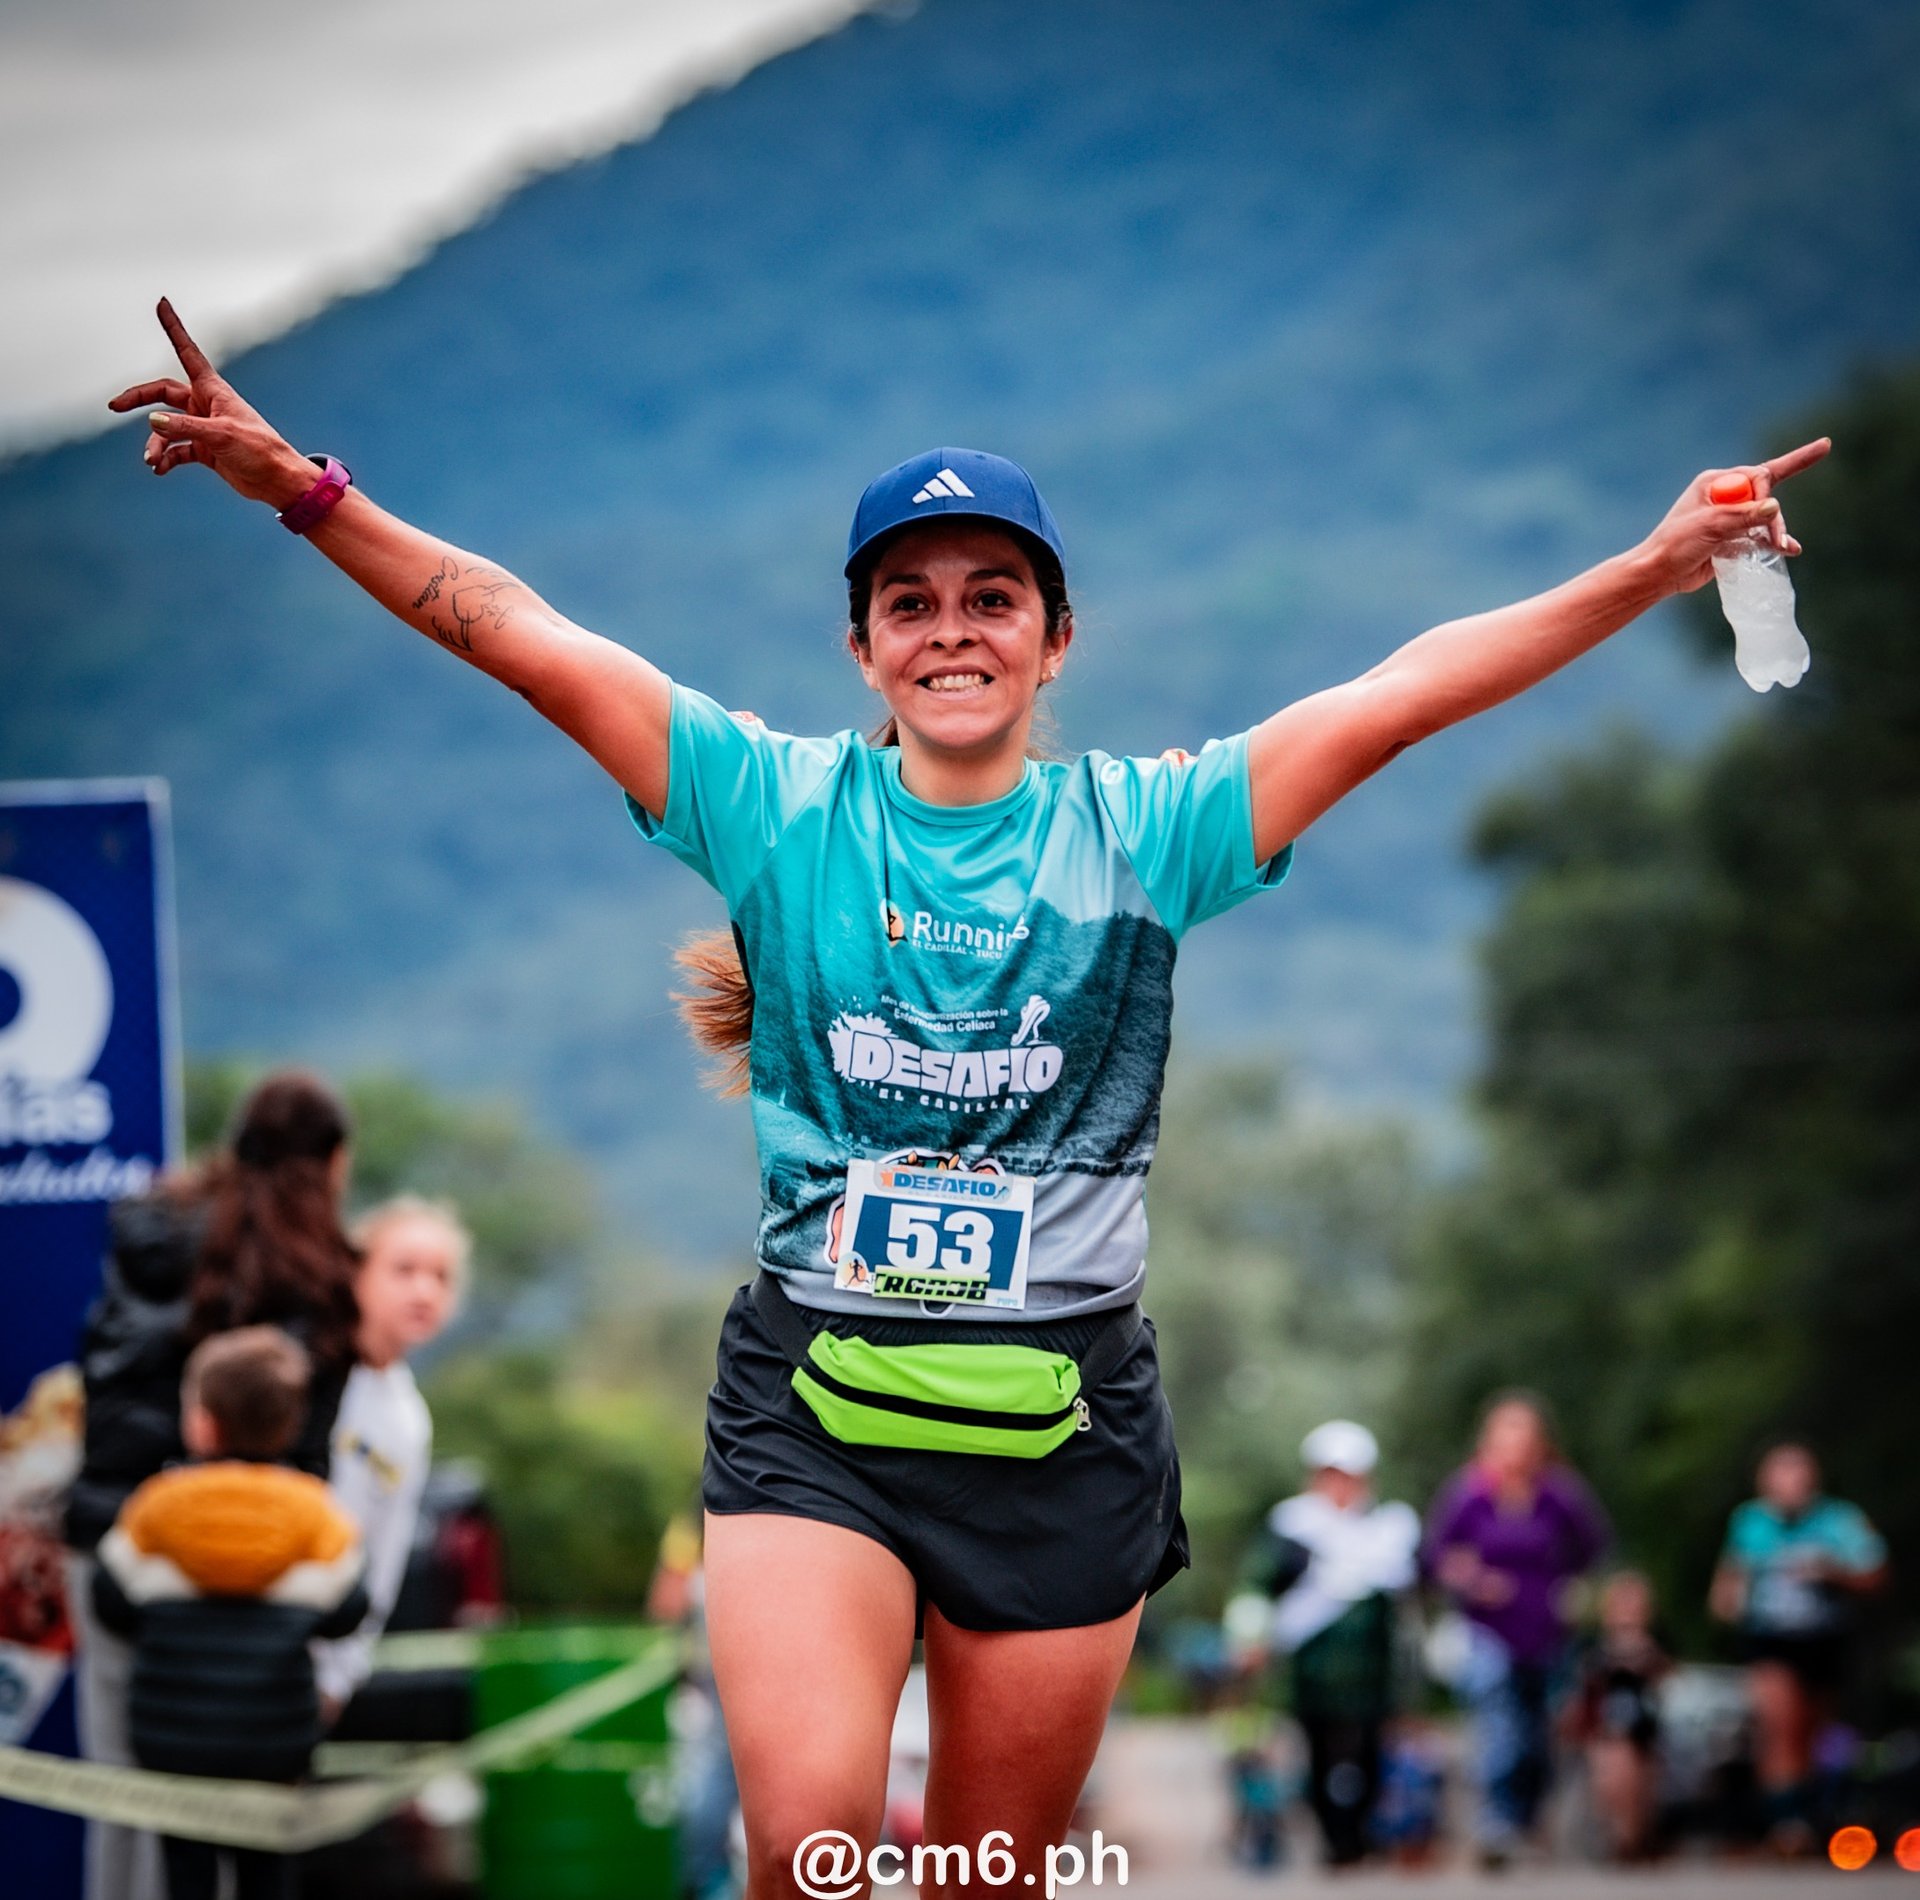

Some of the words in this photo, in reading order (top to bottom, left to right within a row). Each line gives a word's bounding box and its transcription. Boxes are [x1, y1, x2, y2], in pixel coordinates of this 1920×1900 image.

[912, 939, 923, 949] EL
[924, 941, 967, 954] CADILLAL
[850, 1031, 1063, 1098] DESAFIO
[879, 1088, 904, 1101] EL
[920, 1095, 1030, 1113] CADILLAL
[894, 1173, 996, 1196] DESAFIO
[886, 1203, 994, 1276] 53
